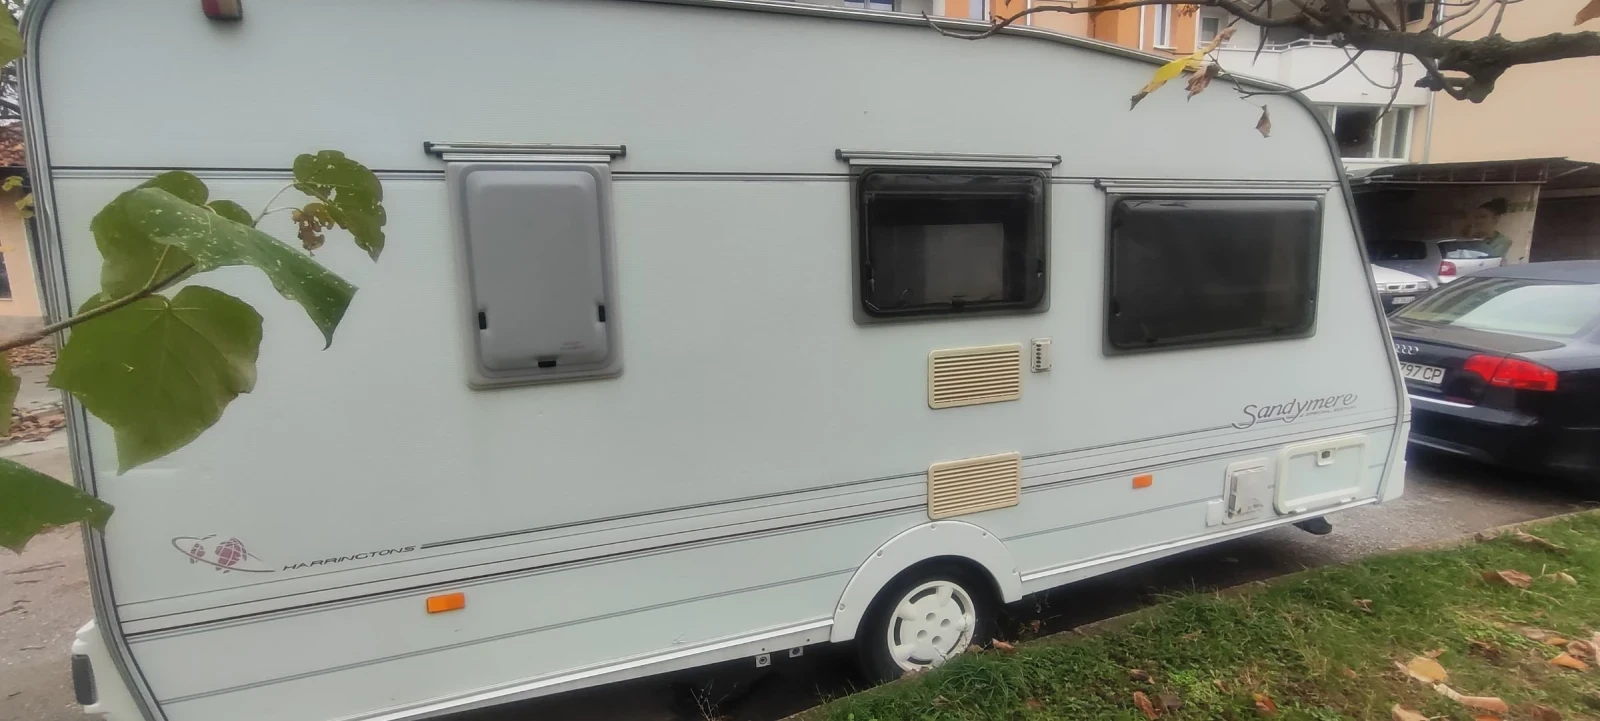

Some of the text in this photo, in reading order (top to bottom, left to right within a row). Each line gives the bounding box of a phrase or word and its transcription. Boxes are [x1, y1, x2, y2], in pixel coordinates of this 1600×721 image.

[1423, 367, 1442, 380] CP
[1231, 393, 1358, 429] Sandymere
[282, 545, 417, 571] HARRINGTONS
